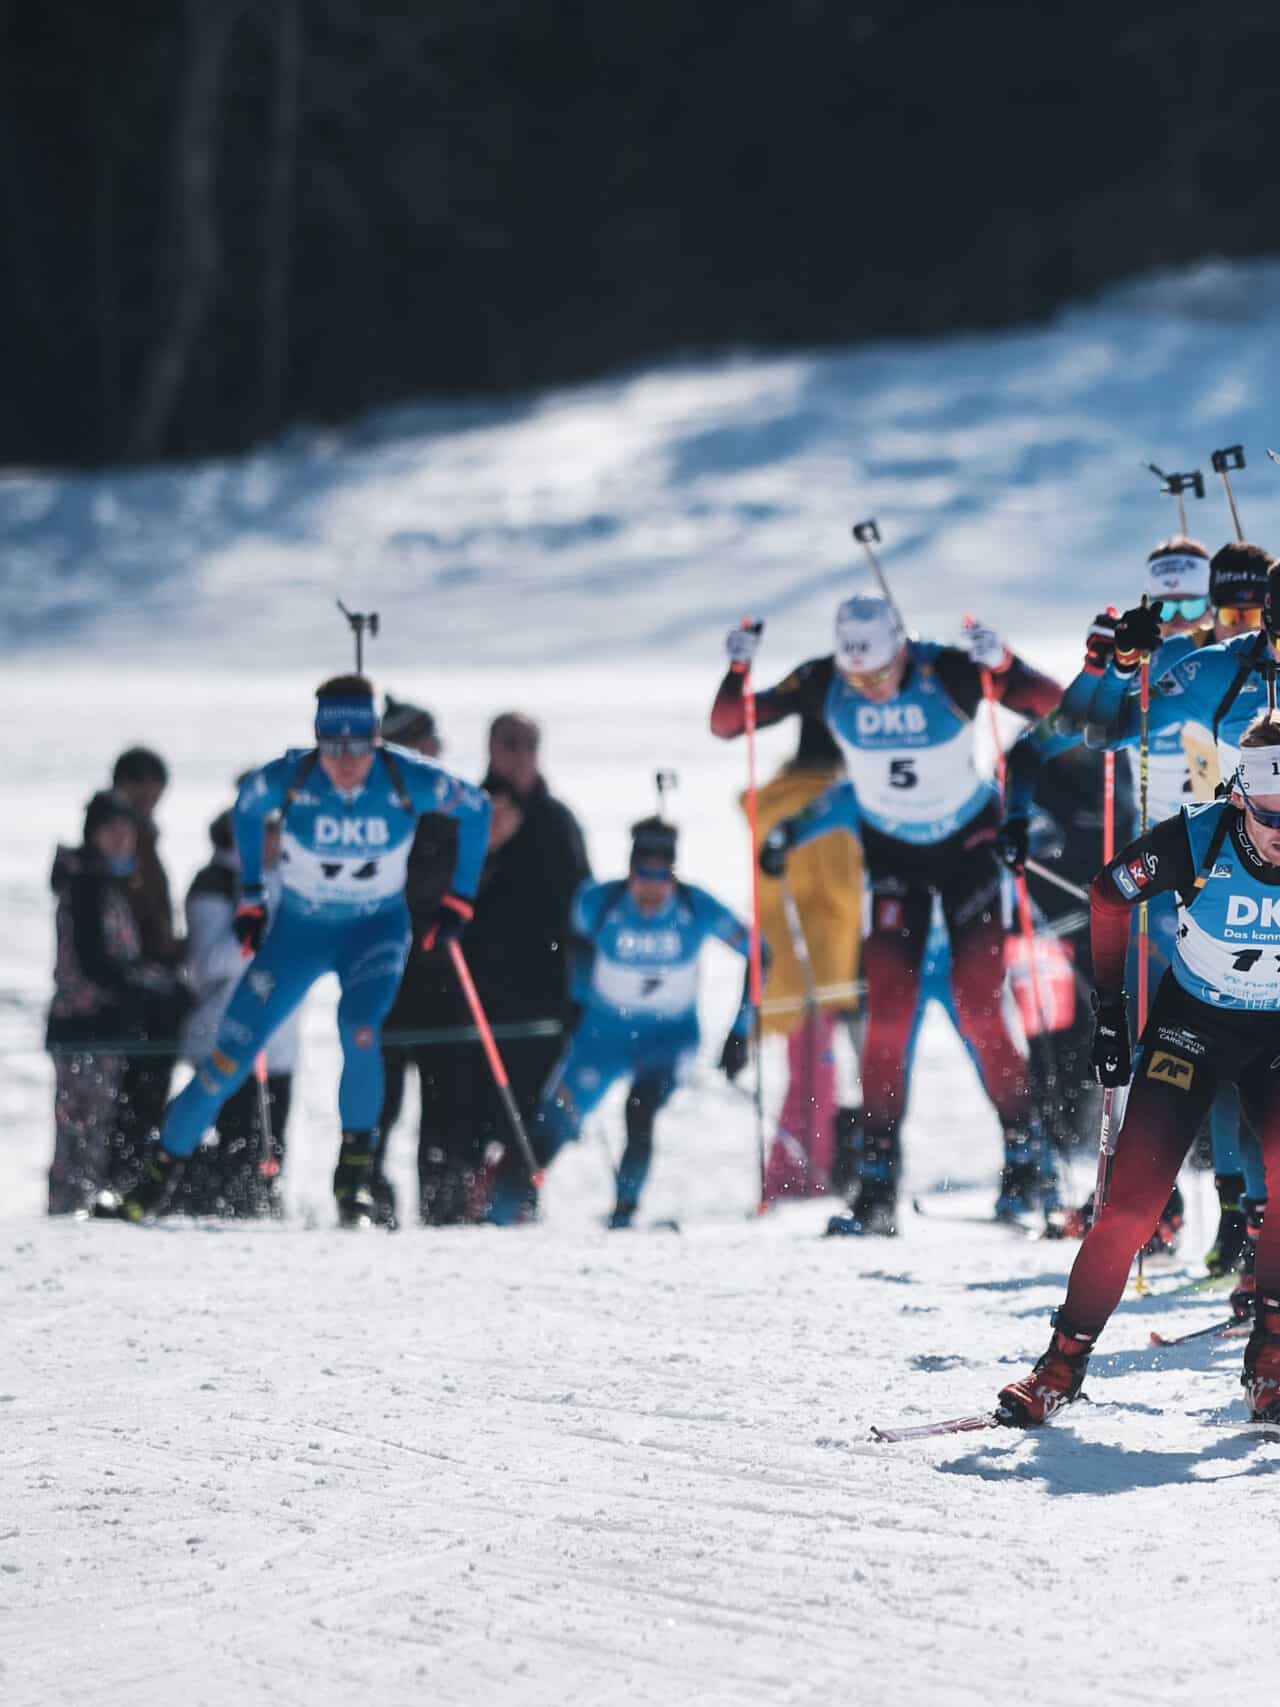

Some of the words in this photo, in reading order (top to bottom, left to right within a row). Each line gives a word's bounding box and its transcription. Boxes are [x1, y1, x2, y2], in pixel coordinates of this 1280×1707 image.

[857, 704, 927, 735] DKB
[889, 757, 918, 790] 5
[314, 815, 390, 845] DKB
[1224, 928, 1248, 939] Das
